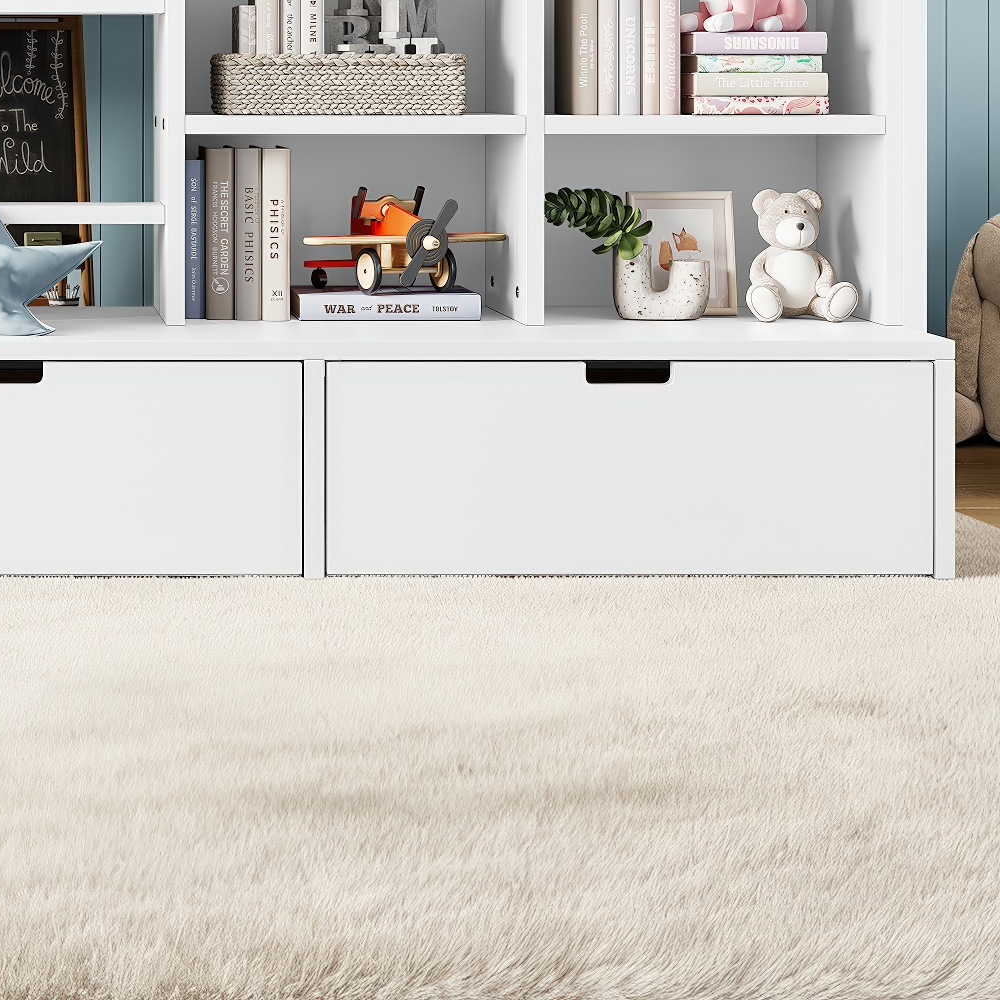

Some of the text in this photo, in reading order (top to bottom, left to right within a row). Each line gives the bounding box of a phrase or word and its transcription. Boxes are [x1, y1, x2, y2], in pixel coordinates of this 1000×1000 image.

[664, 2, 676, 28] Web
[579, 13, 588, 88] Winnie The Pooh
[724, 36, 800, 50] DINOSAURS
[716, 77, 809, 88] The Little Prince
[9, 108, 38, 132] The
[221, 180, 229, 275] THE SECRET GARDEN
[244, 187, 254, 283] BASIC PHISICS
[269, 199, 279, 259] PHISICS
[324, 304, 356, 314] WAR
[377, 304, 420, 314] PEACE
